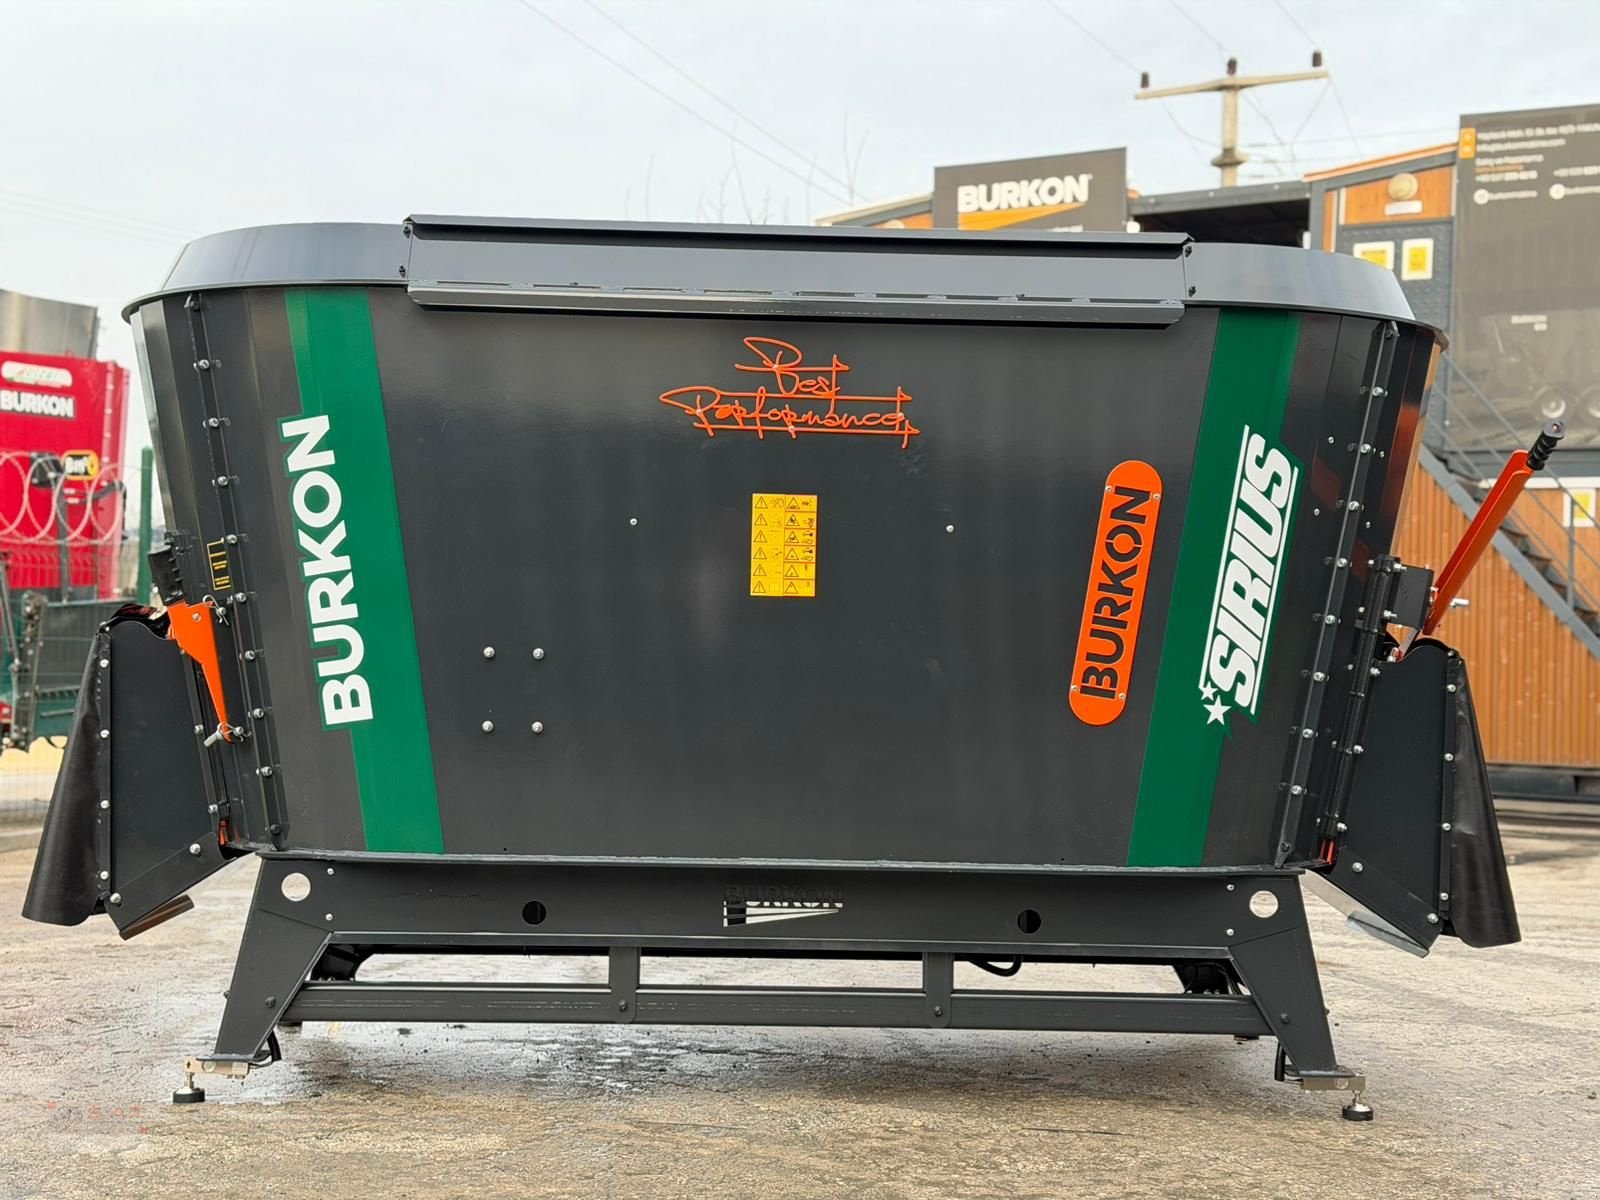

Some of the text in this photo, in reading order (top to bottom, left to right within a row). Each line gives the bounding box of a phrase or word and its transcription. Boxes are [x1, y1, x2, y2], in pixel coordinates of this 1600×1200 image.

[957, 174, 1089, 213] BURKON
[0, 389, 75, 418] BURKON
[734, 336, 849, 415] Best
[282, 415, 374, 725] BURKON
[1080, 485, 1151, 700] BURKON
[1209, 433, 1292, 707] SIRIUS
